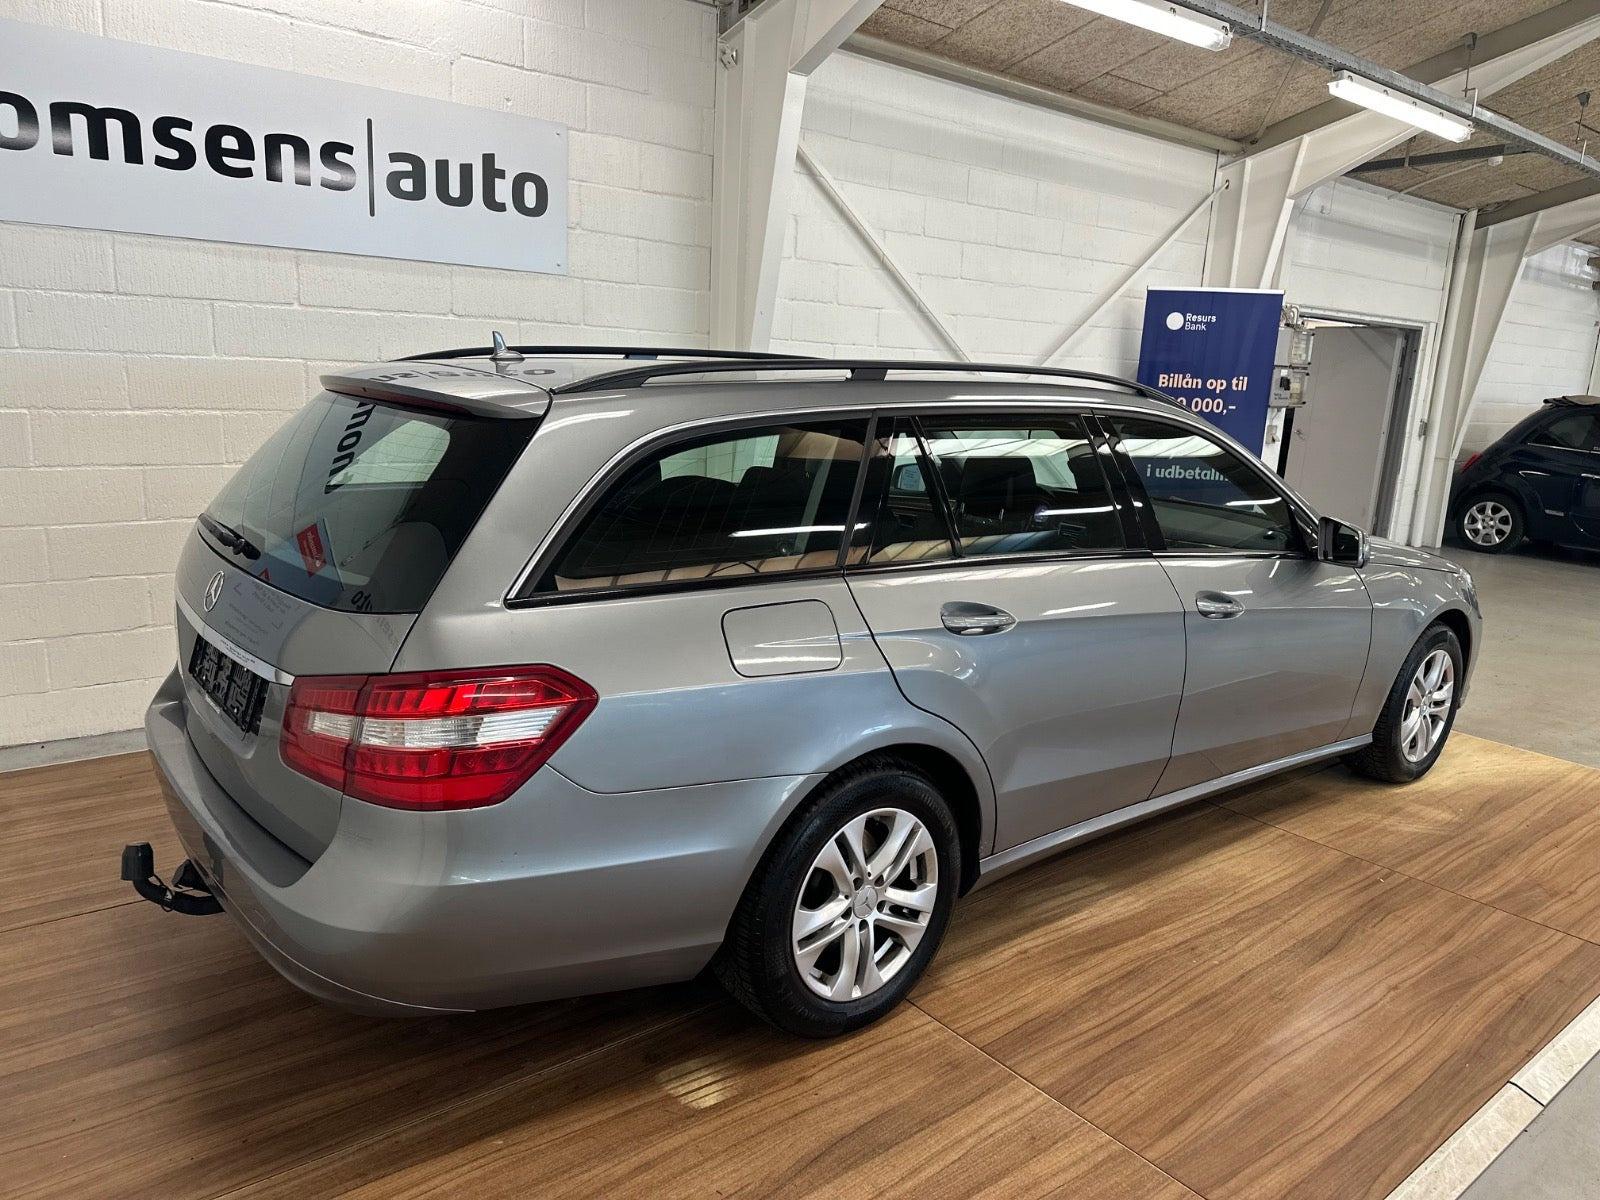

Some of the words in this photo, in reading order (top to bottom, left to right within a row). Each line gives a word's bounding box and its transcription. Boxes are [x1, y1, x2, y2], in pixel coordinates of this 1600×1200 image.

[386, 151, 549, 218] auto
[1185, 313, 1217, 322] Resurs
[1185, 321, 1206, 331] Bank
[1158, 373, 1202, 389] Billån
[1206, 378, 1227, 394] op
[1231, 376, 1248, 391] til
